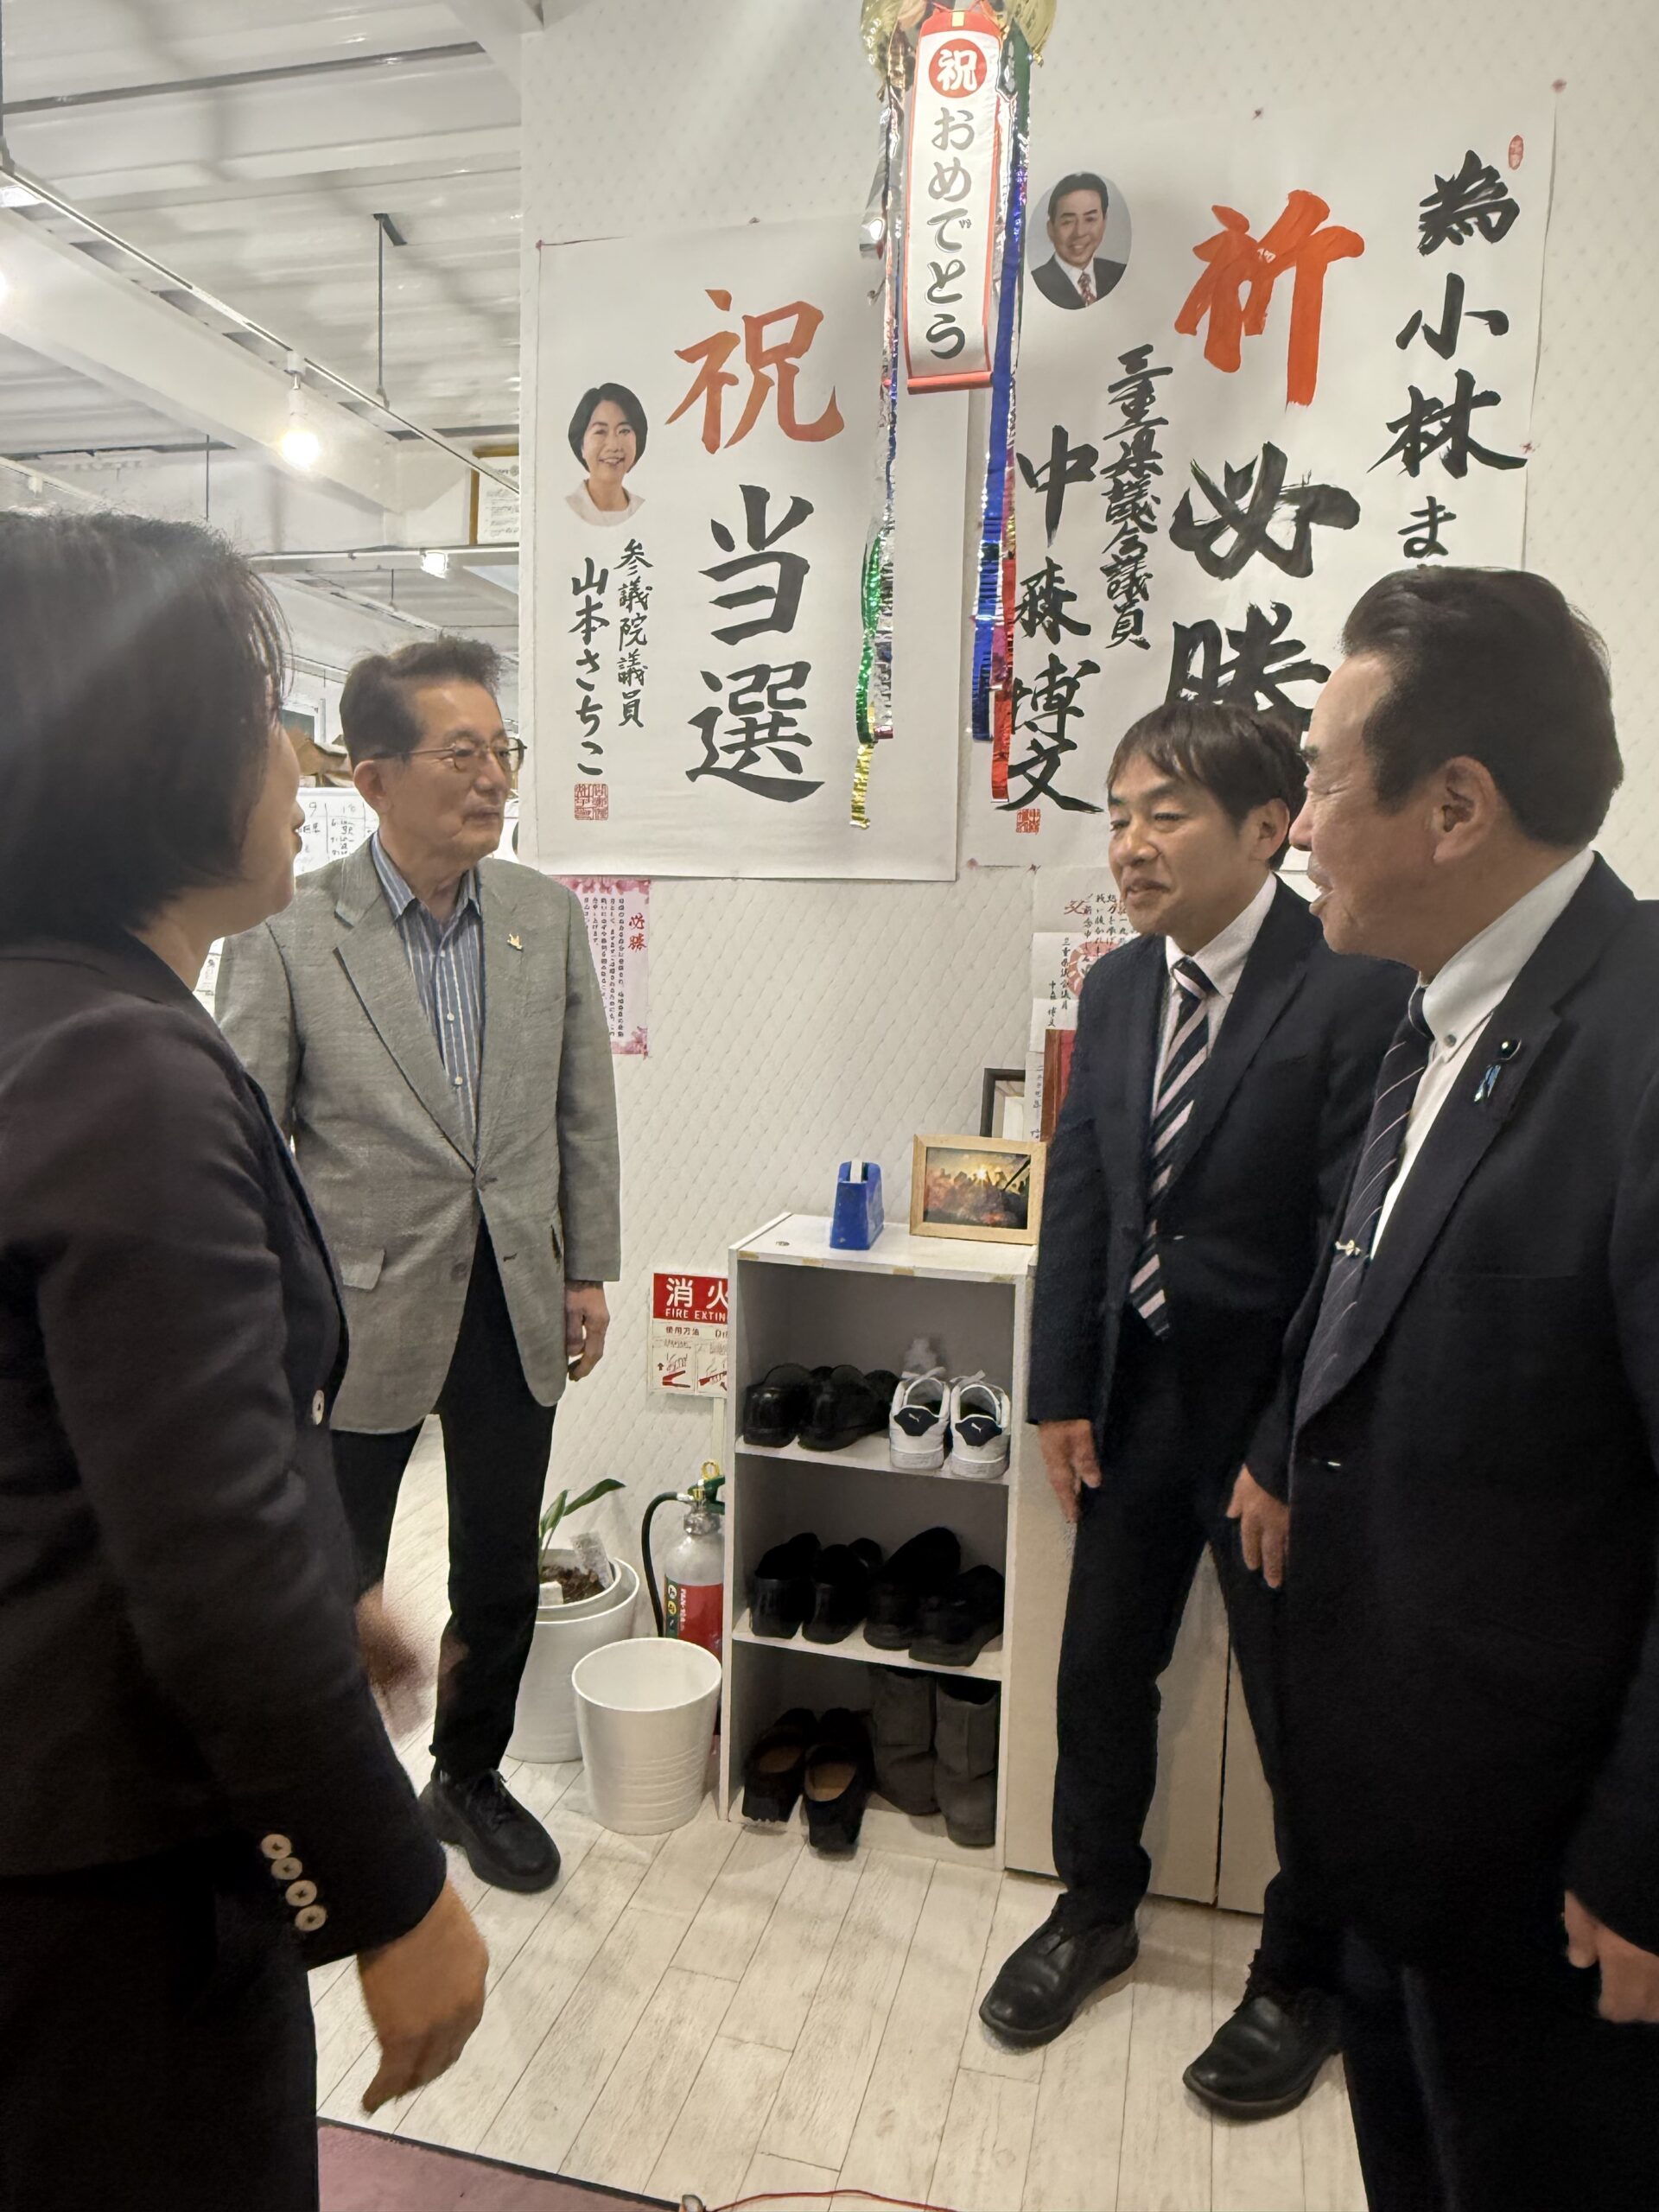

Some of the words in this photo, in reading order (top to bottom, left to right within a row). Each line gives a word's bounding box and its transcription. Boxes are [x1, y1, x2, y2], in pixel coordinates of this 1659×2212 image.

[936, 48, 978, 91] 祝
[925, 106, 975, 359] おめでとう
[1366, 149, 1528, 568] 為小林ま
[568, 556, 610, 776] 山本さちこ
[613, 538, 654, 728] 参議院議員
[995, 424, 1104, 813] 中森博文
[628, 912, 647, 953] 必勝
[665, 1277, 728, 1309] 消火
[665, 1308, 689, 1319] FIRE
[695, 1311, 726, 1321] EXTIN
